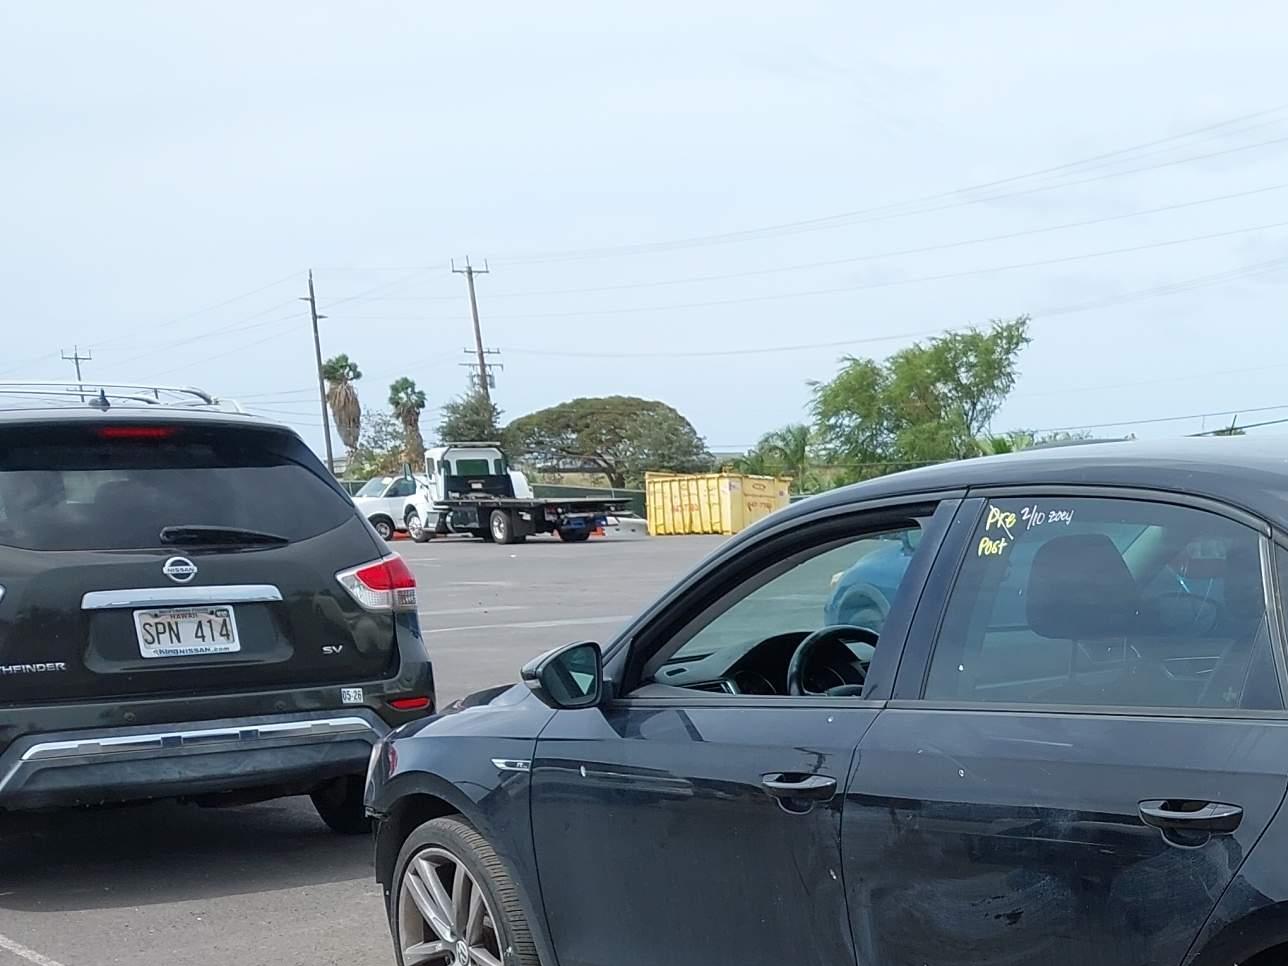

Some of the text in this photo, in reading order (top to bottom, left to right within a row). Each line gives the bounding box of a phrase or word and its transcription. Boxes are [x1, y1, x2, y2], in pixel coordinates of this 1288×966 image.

[1020, 505, 1046, 530] 2/10
[142, 618, 230, 645] SPN 414
[322, 645, 343, 654] SV
